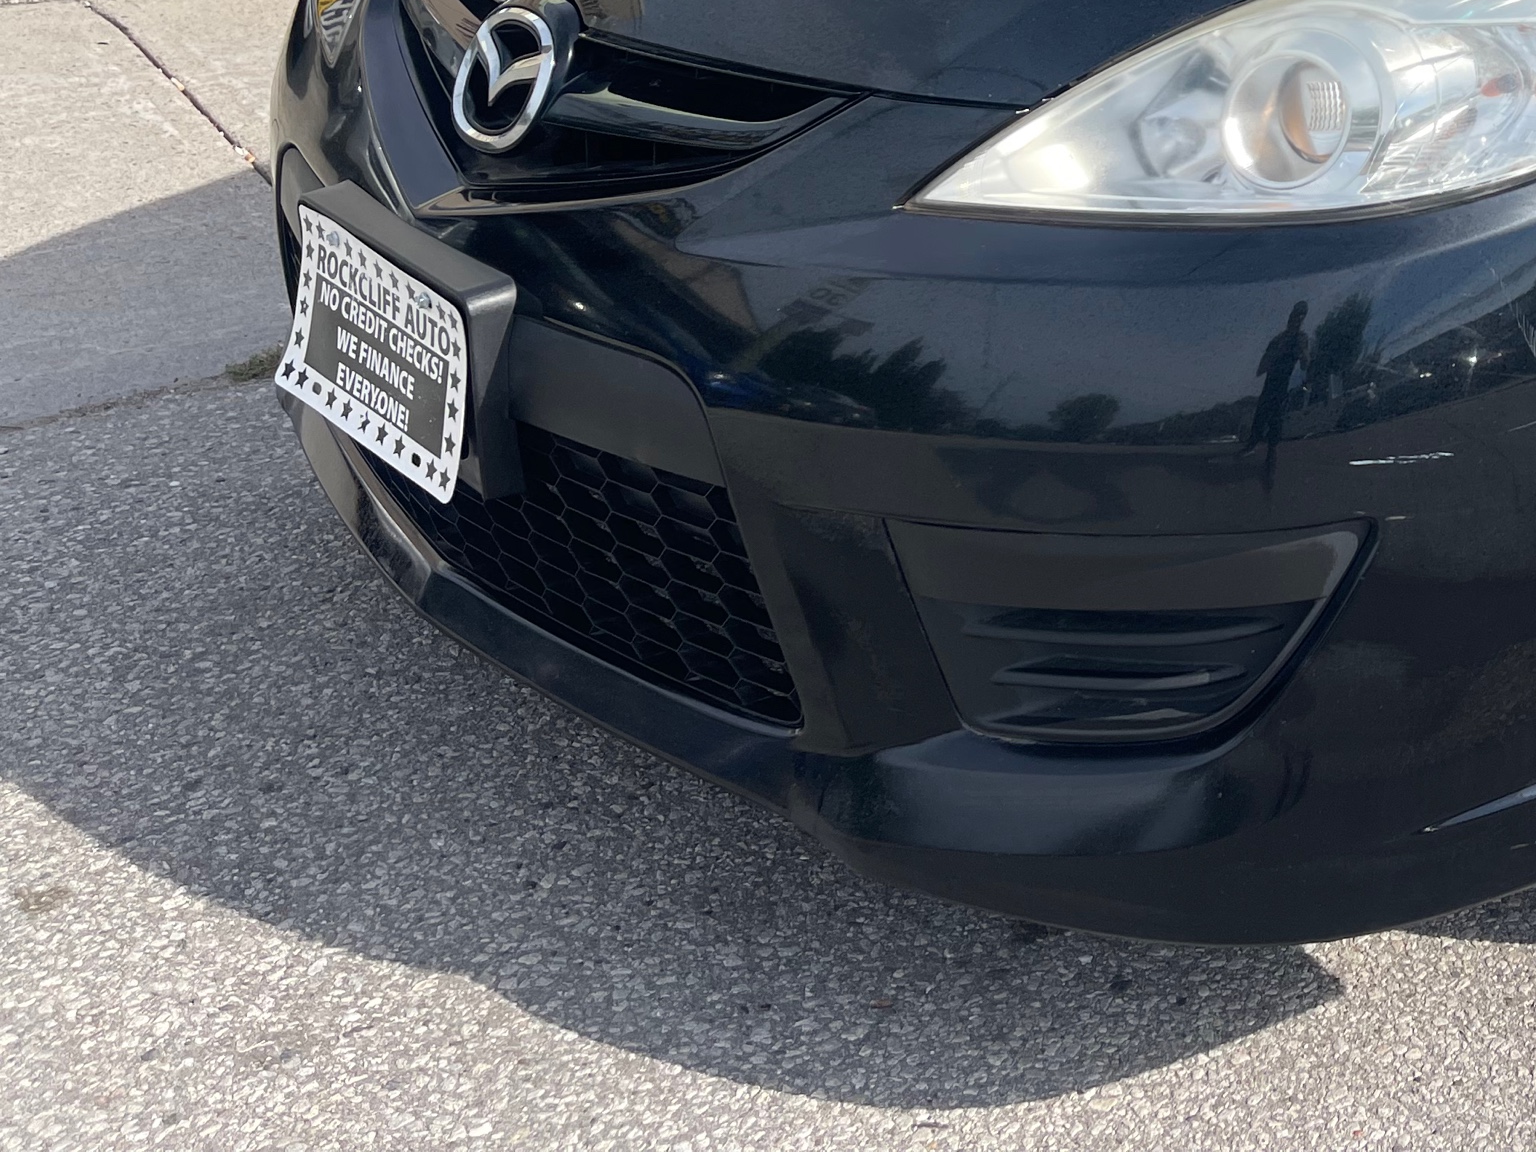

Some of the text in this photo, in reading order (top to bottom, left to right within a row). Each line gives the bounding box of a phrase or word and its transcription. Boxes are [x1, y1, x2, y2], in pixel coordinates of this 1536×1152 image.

[317, 244, 450, 357] ROCKCLIFF AUTO
[320, 281, 444, 385] NO CREDIT CHECKS!
[336, 361, 410, 432] EVERYONE!
[337, 326, 415, 400] WE FINANCE
